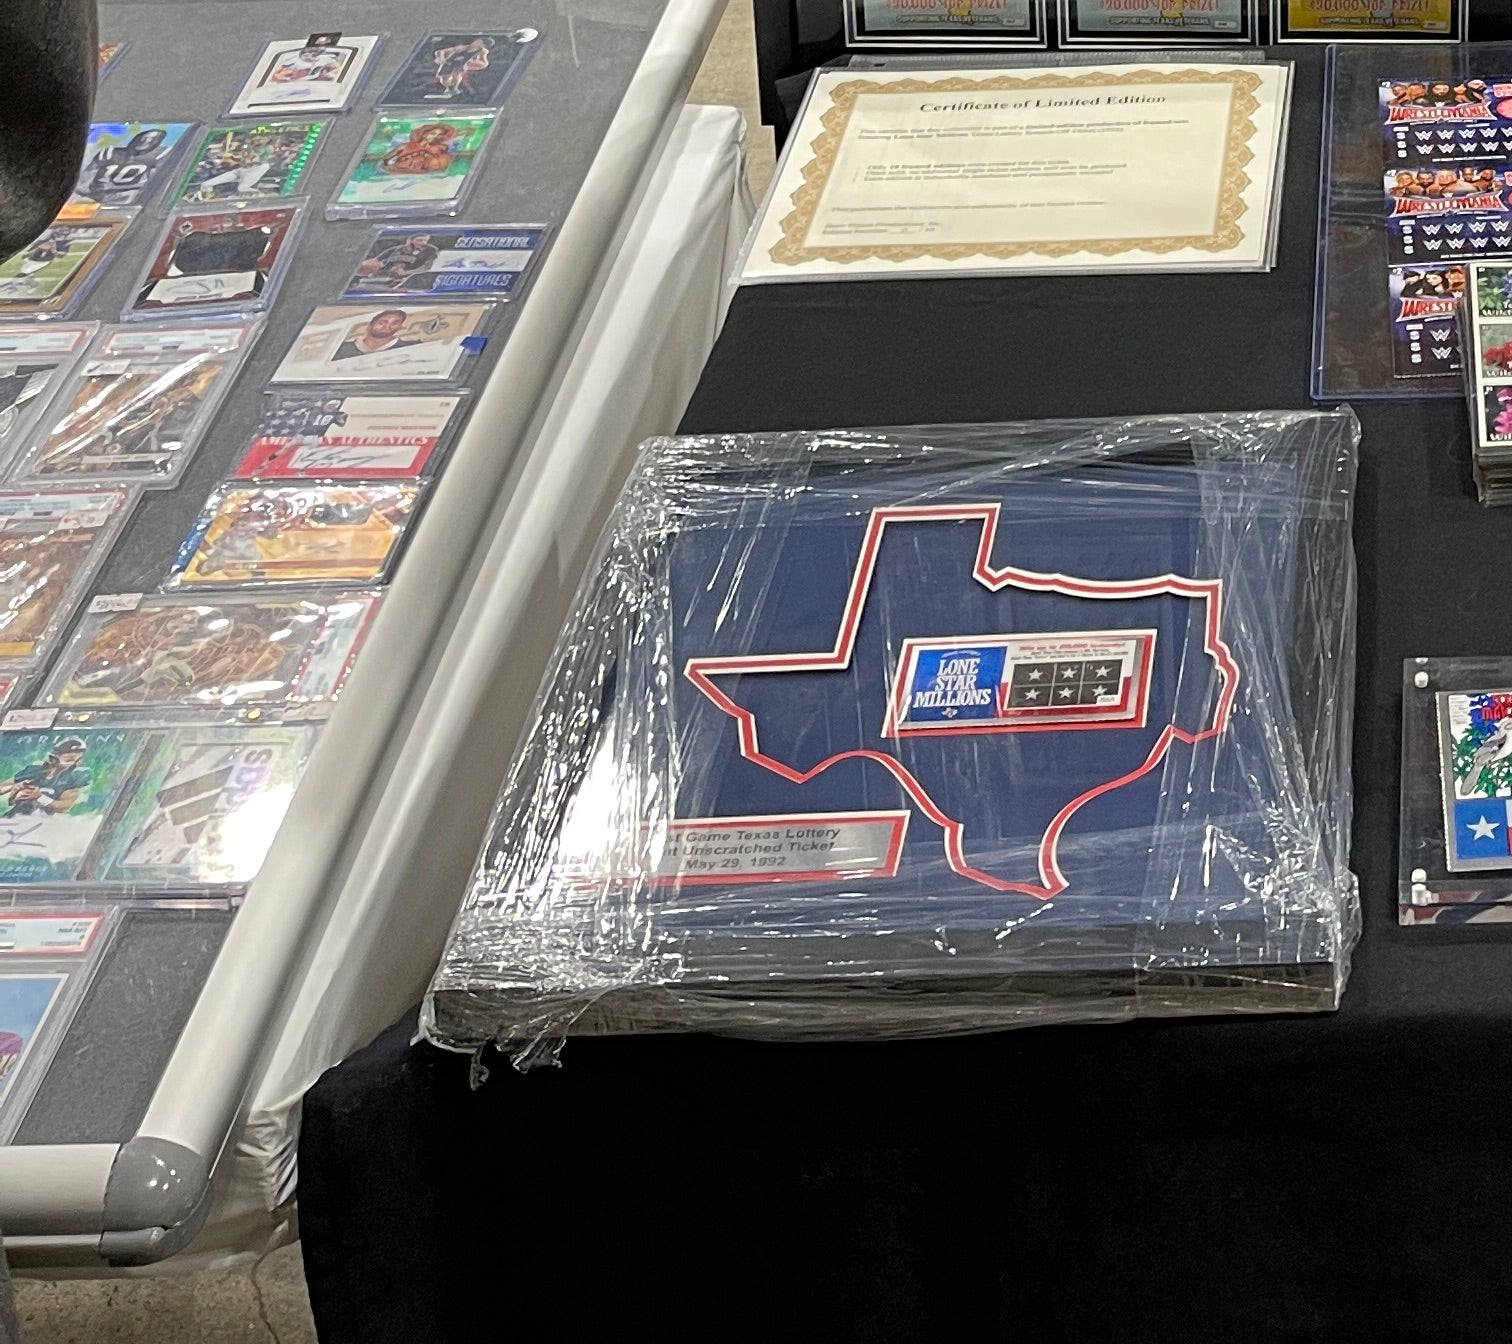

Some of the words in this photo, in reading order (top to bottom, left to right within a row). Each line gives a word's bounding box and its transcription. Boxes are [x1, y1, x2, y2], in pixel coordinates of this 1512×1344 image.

[919, 101, 1009, 113] Certificate
[1013, 100, 1032, 109] of
[1034, 97, 1102, 109] Limited
[1105, 94, 1167, 105] Edition
[1391, 104, 1492, 122] WRESTLEMANIA
[99, 164, 146, 184] 10
[1396, 195, 1503, 213] WRESTLEMANIA
[454, 236, 531, 248] SENSATIONAL
[433, 274, 512, 287] SIGNATURES
[937, 658, 980, 675] LONE
[934, 674, 977, 691] STAR
[913, 689, 991, 709] MILLIONS
[686, 830, 731, 843] Game
[737, 829, 780, 841] Texas
[785, 828, 840, 842] Lottery
[682, 842, 782, 856] Unscratched
[787, 841, 835, 854] Ticket
